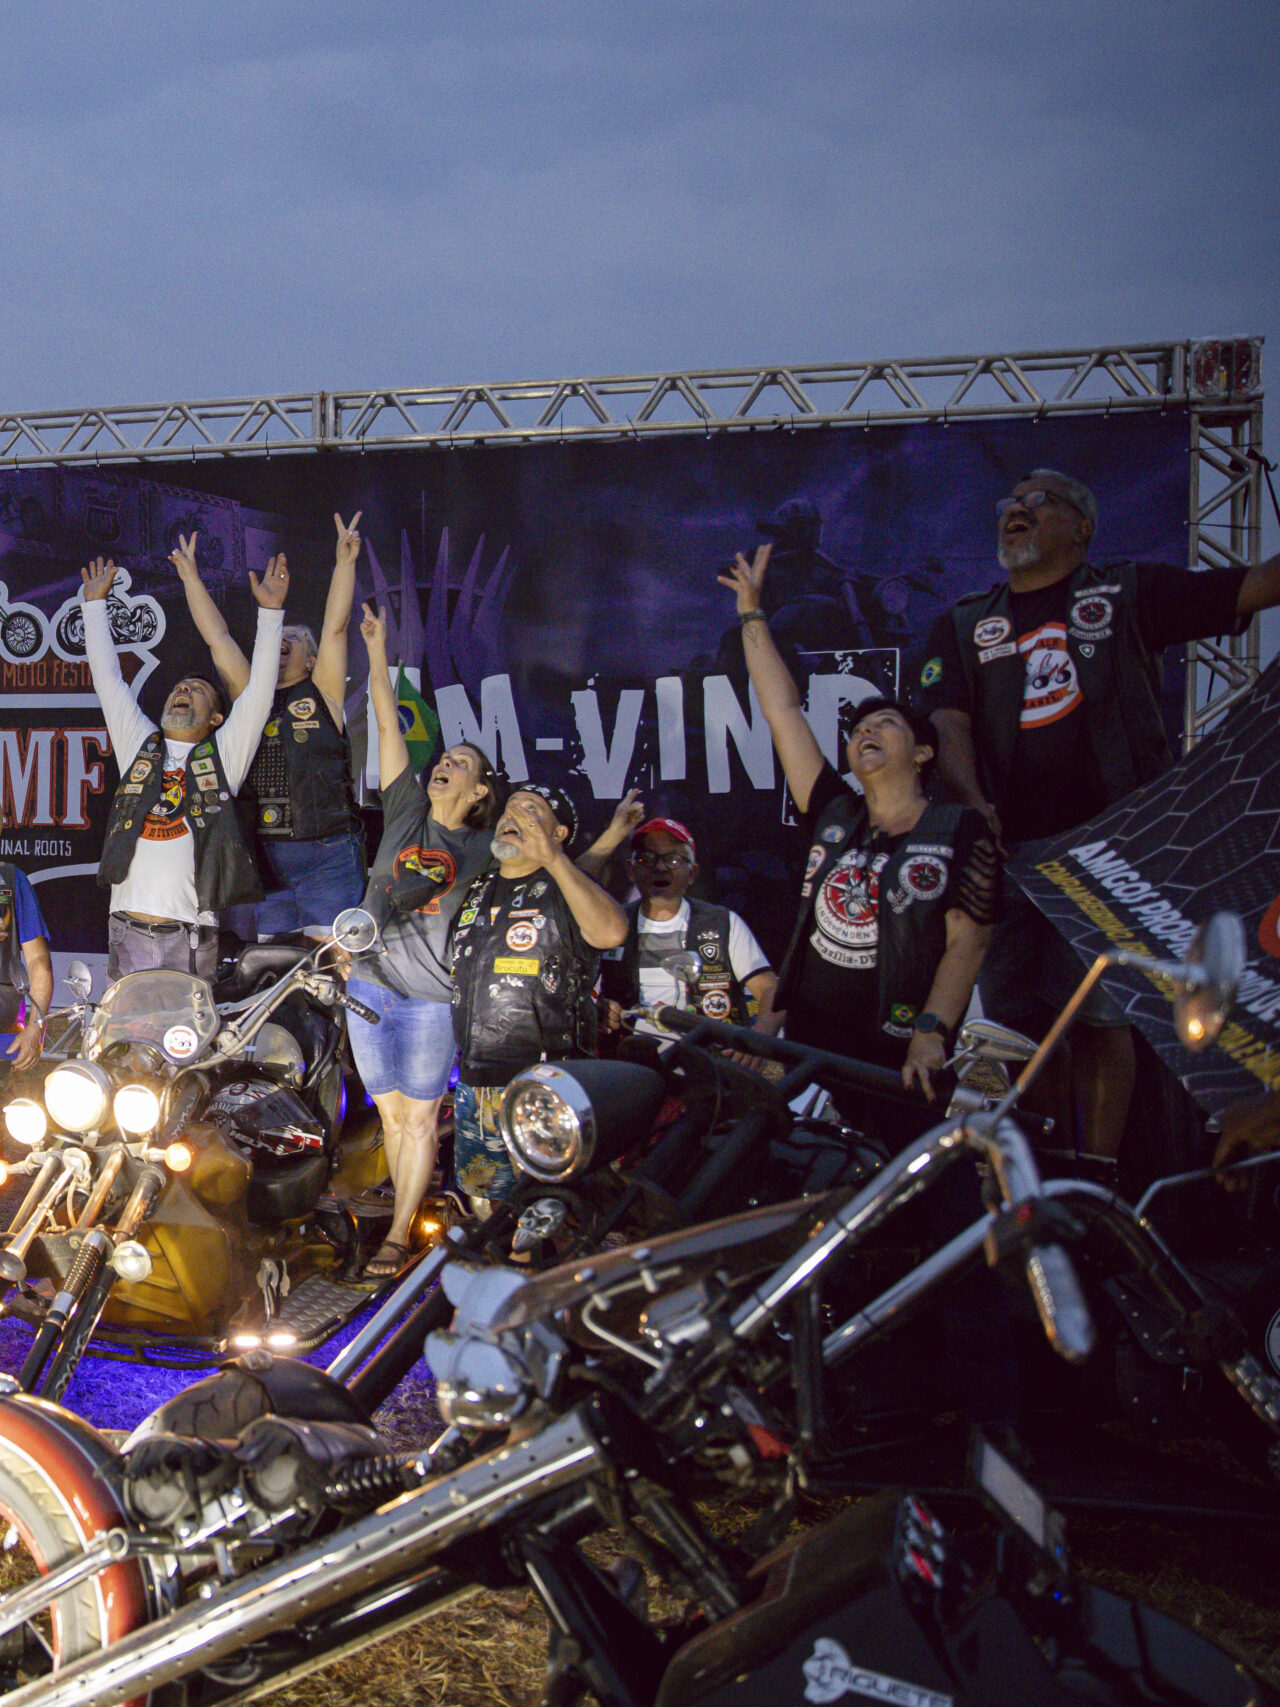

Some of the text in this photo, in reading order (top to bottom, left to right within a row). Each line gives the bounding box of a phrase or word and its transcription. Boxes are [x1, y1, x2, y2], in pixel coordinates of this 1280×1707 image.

[3, 661, 47, 688] MOTO
[53, 660, 94, 687] FESTI
[34, 839, 72, 856] ROOTS
[1068, 840, 1161, 903] AMIGOS
